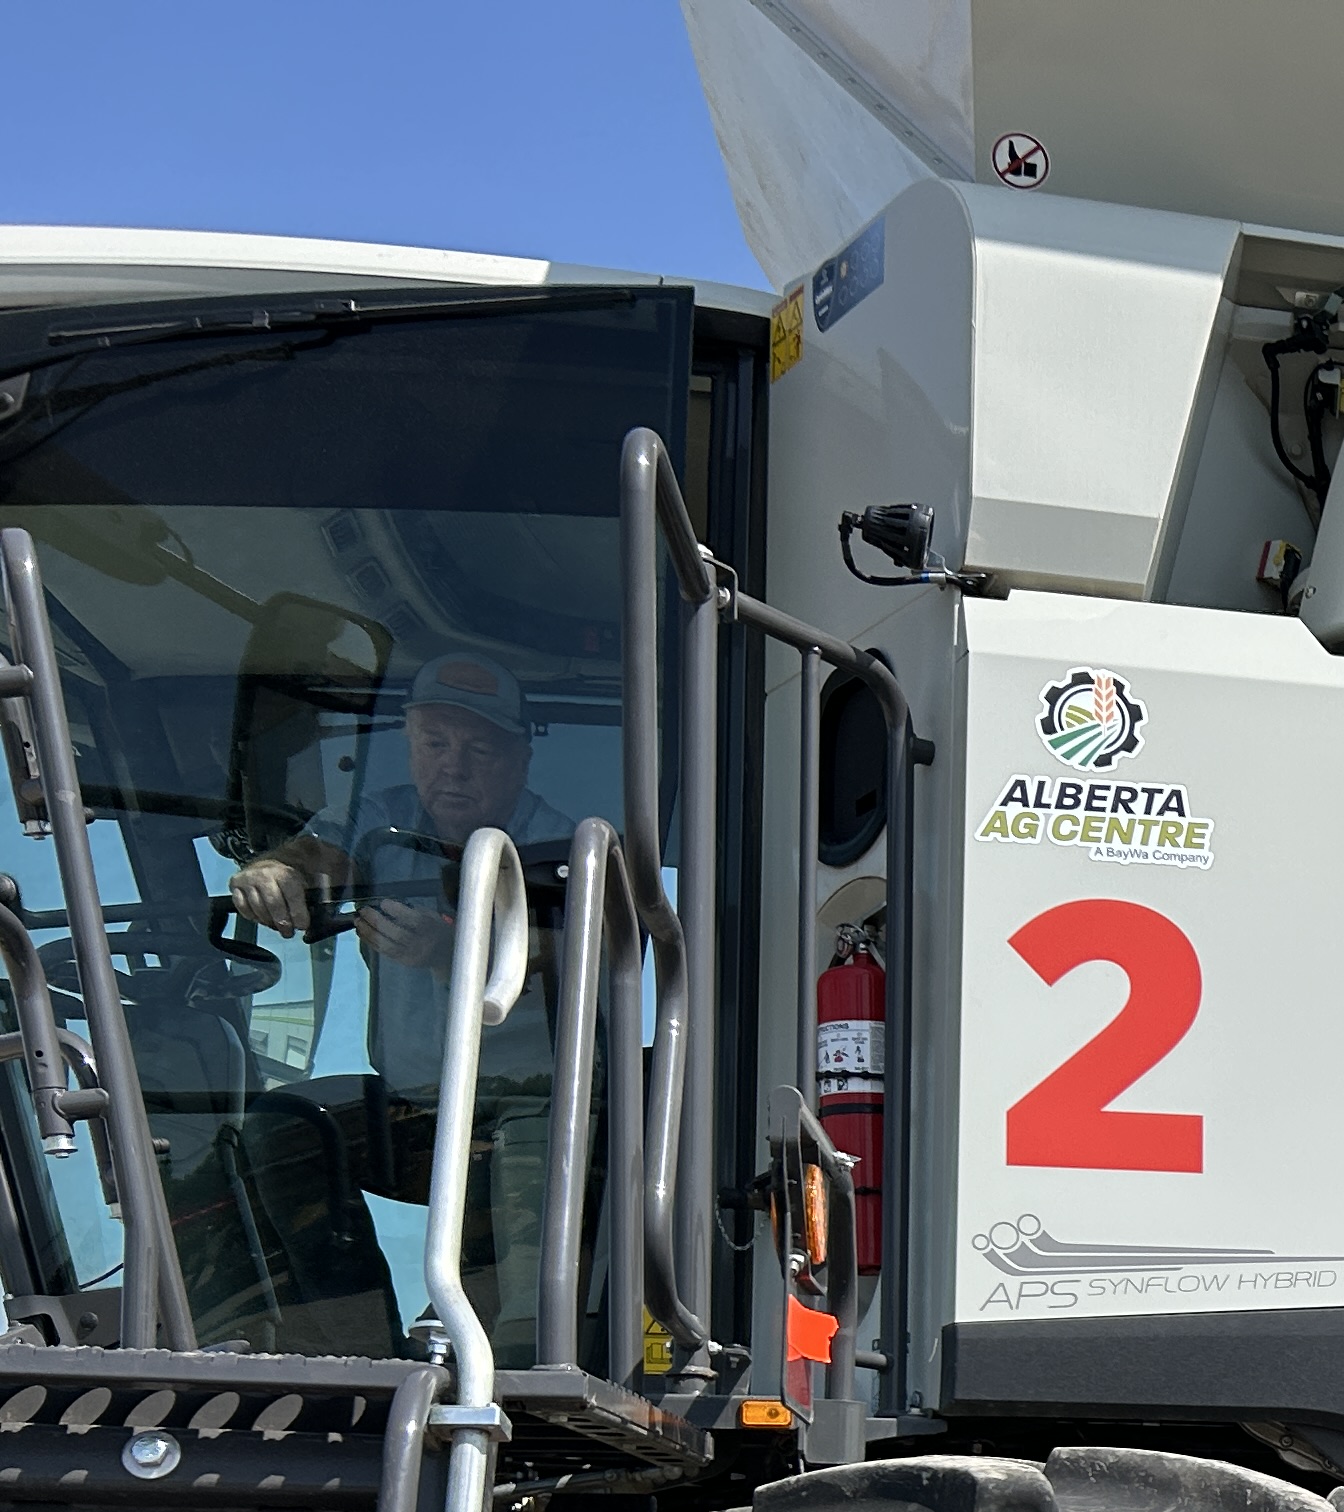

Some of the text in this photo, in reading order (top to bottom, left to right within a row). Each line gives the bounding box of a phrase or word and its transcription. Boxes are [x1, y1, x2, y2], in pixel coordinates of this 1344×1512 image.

[999, 779, 1186, 817] ALBERTA
[980, 810, 1209, 849] AG CENTRE
[1094, 847, 1210, 866] A BayWa Company
[1006, 898, 1203, 1173] 2
[979, 1270, 1337, 1311] APS SYNFLOW HYBRID
